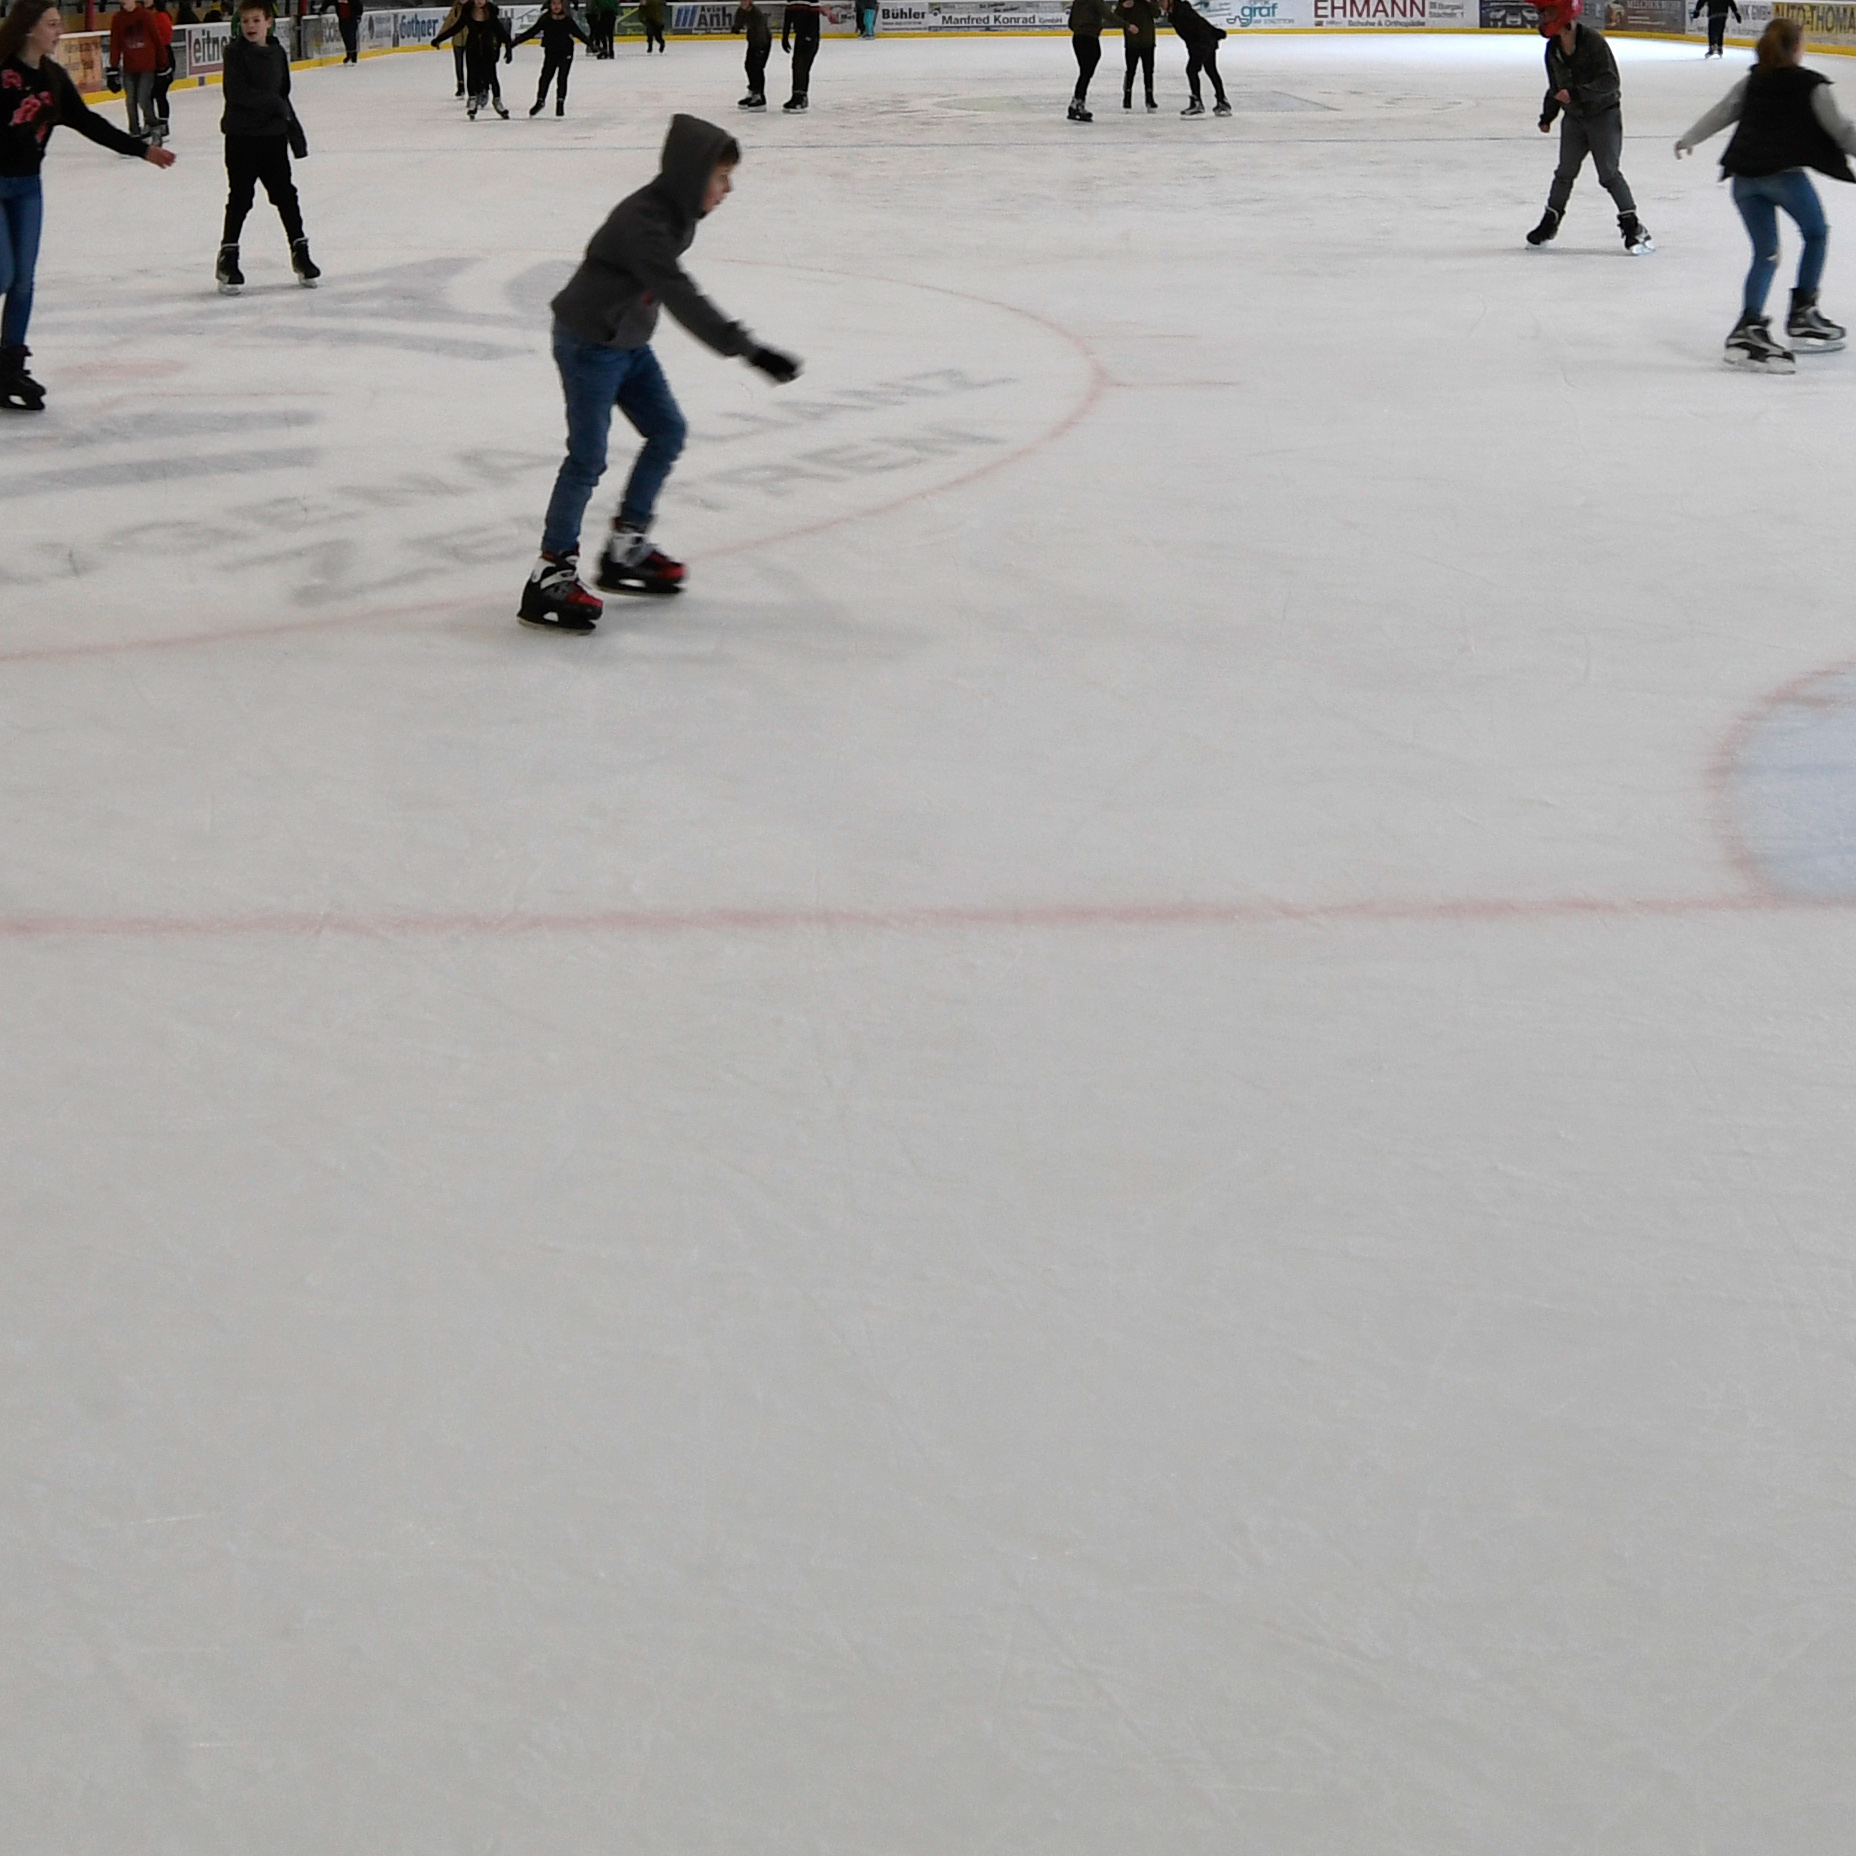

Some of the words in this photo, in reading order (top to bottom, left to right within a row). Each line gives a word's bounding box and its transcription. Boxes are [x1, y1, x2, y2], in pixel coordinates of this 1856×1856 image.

[882, 8, 926, 20] Bühler
[942, 14, 990, 25] Manfred
[993, 14, 1036, 25] Konrad
[1240, 2, 1278, 27] graf
[1347, 19, 1376, 27] Schuhe
